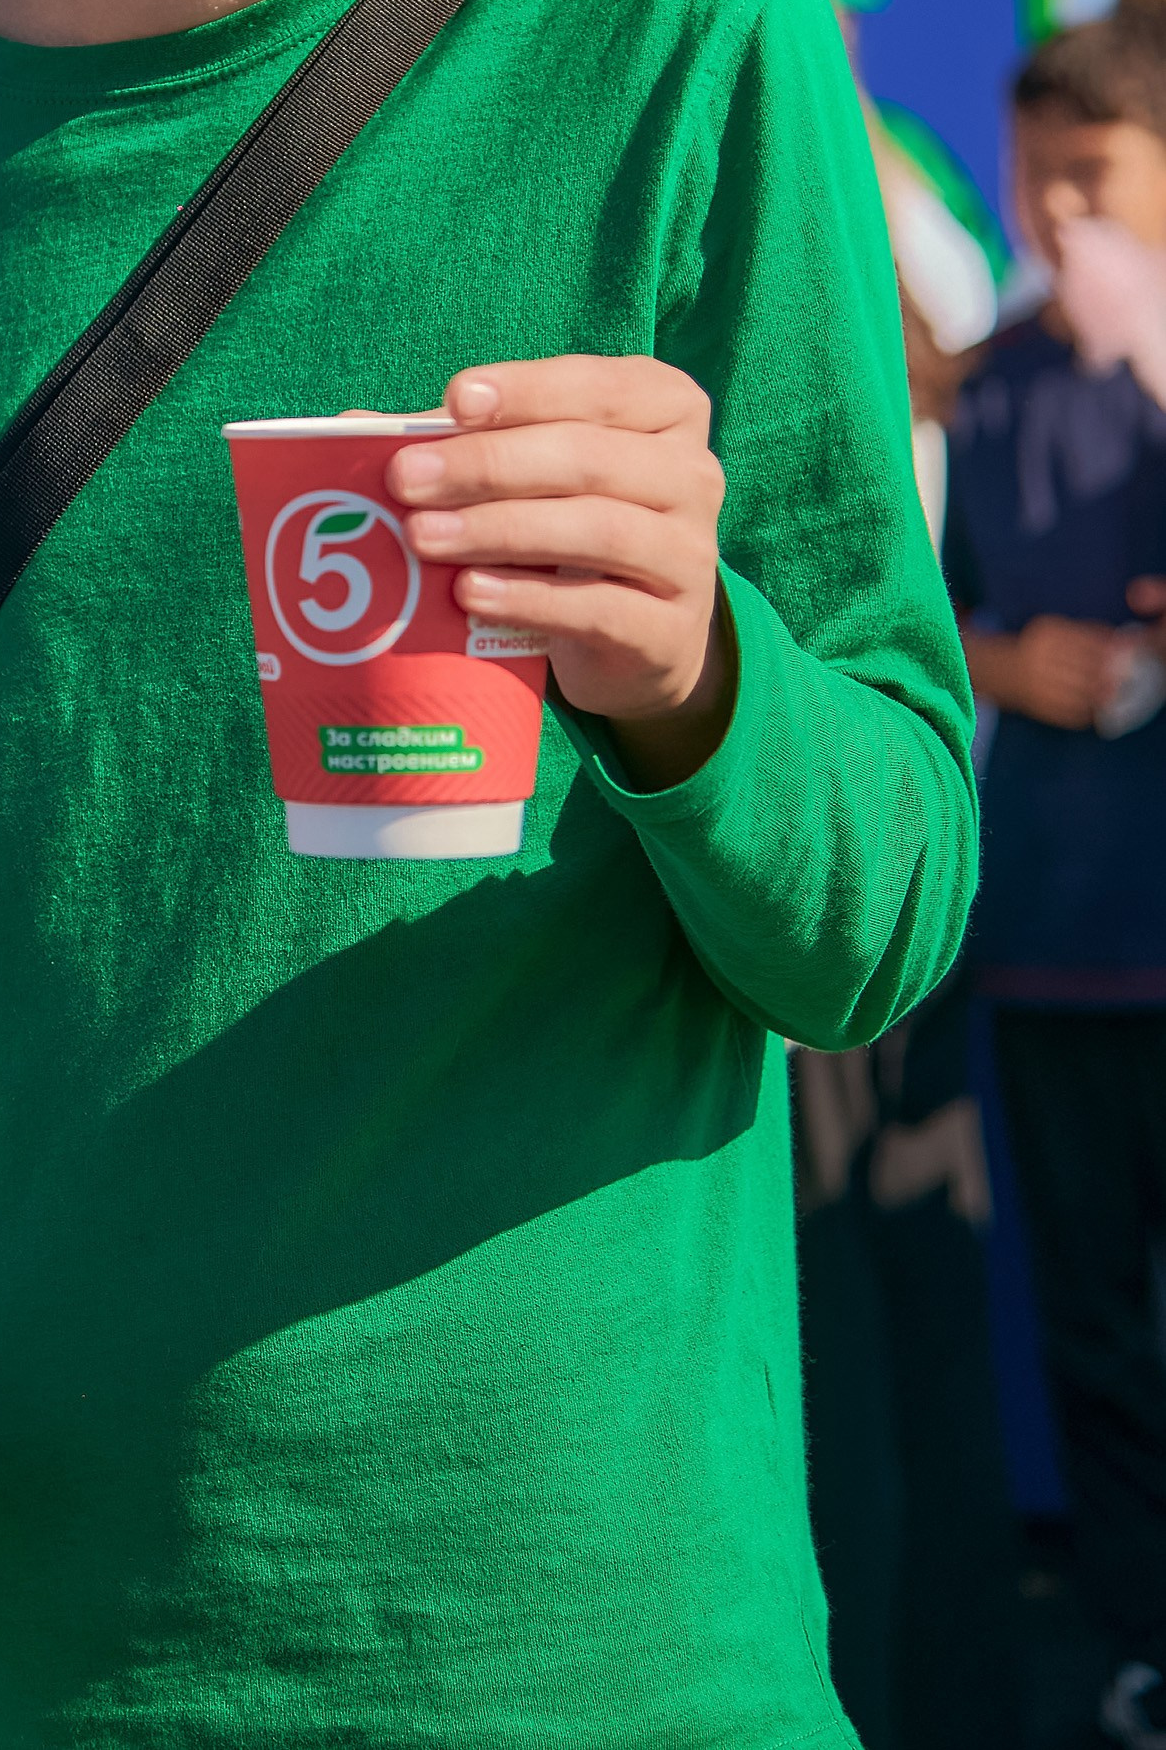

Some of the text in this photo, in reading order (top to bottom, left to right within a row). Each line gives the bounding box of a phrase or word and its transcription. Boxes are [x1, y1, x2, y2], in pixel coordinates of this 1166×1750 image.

[297, 504, 377, 632] 5
[475, 635, 548, 651] атмосф
[326, 726, 457, 748] За сладким
[327, 752, 477, 774] настроением
